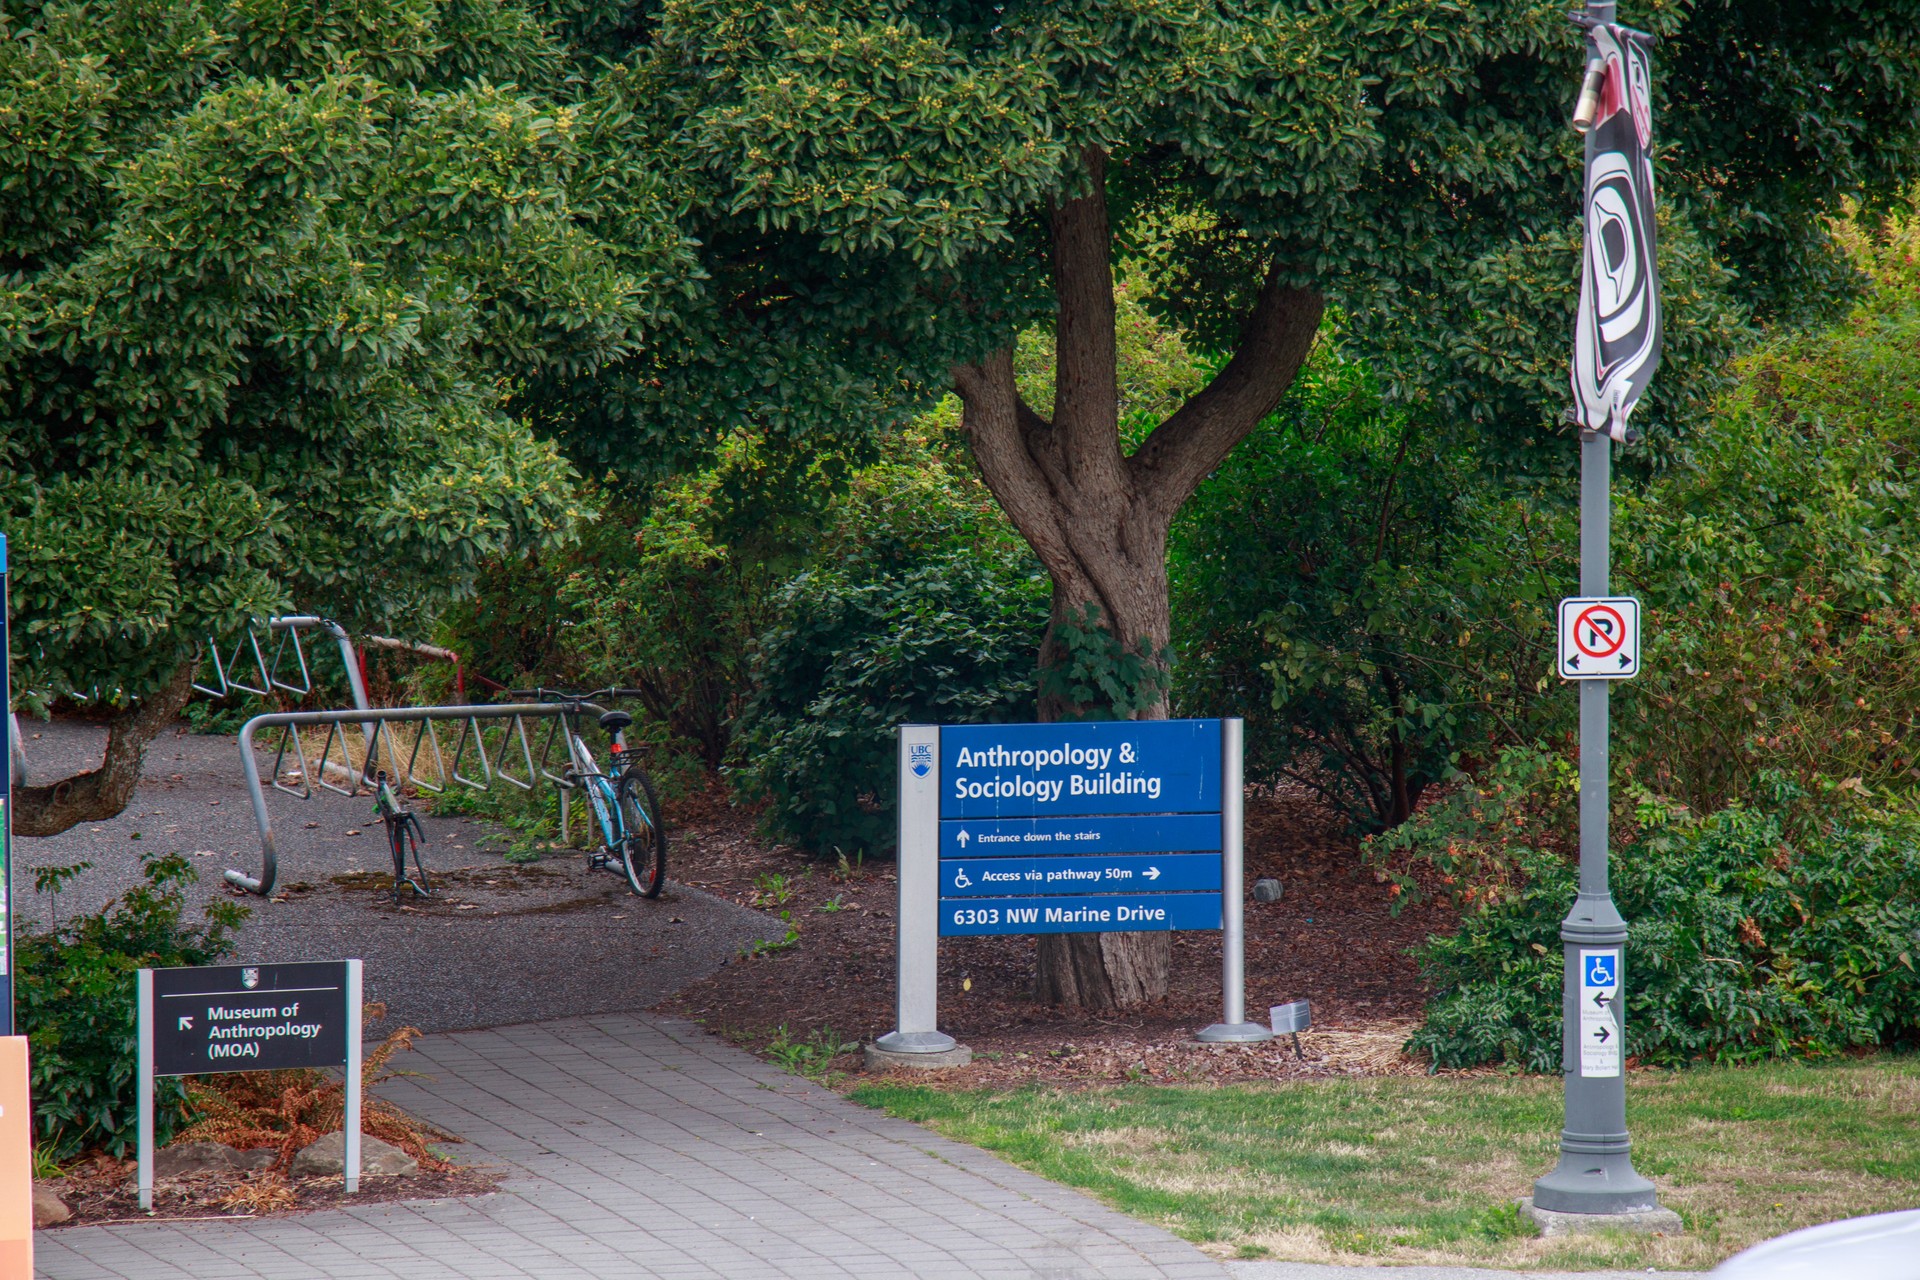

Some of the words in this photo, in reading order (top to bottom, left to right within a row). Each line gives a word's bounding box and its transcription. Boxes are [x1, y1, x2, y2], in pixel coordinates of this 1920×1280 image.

[910, 745, 931, 754] UBC
[956, 743, 1112, 771] Anthropology
[1118, 743, 1136, 764] &
[955, 775, 1063, 801] Sociology
[1070, 772, 1161, 798] Building
[978, 833, 1020, 843] Entrance
[1024, 831, 1052, 842] down
[1055, 830, 1071, 841] the
[1074, 830, 1101, 841] stairs
[982, 871, 1021, 882] Access
[1025, 870, 1043, 881] via
[1047, 868, 1101, 883] pathway
[1105, 868, 1132, 879] 50m
[954, 909, 999, 924] 6303
[1007, 908, 1039, 923] NW
[1045, 907, 1111, 922] Marine
[1117, 906, 1165, 921] Drive
[208, 1006, 277, 1020] Museum
[281, 1003, 299, 1017] of
[209, 1022, 320, 1039] Anthropology
[208, 1042, 259, 1059] (MOA)
